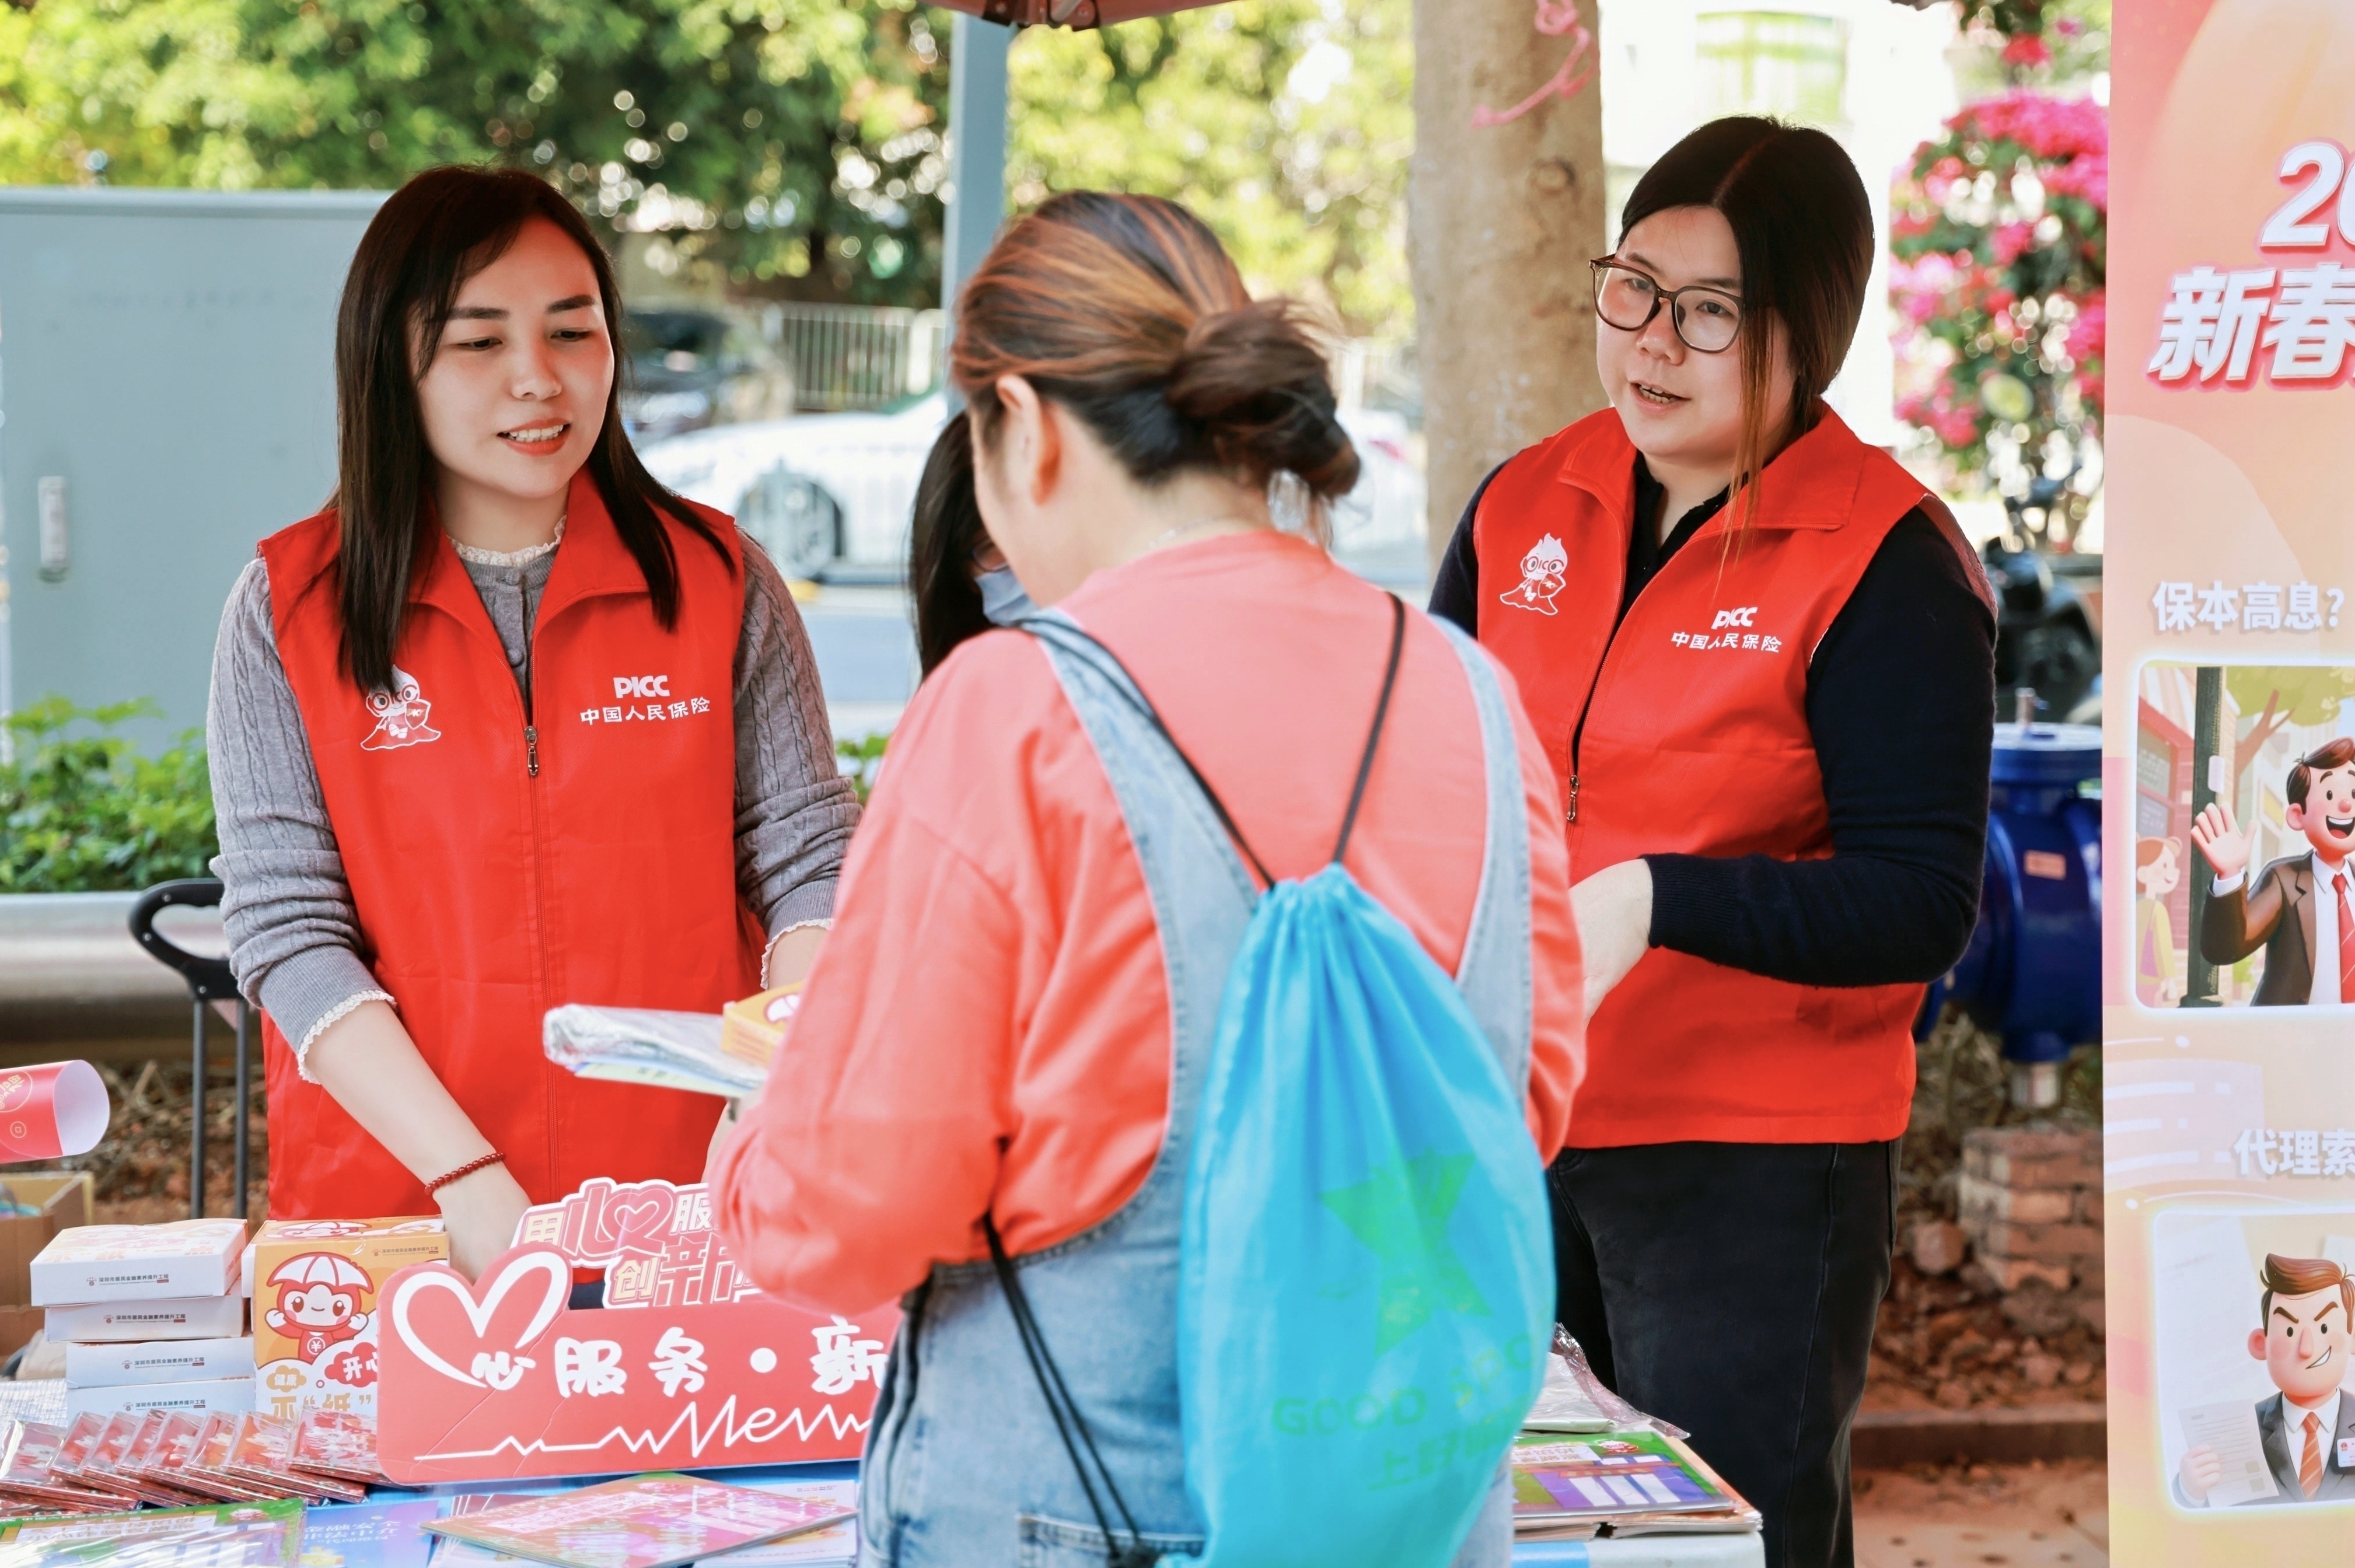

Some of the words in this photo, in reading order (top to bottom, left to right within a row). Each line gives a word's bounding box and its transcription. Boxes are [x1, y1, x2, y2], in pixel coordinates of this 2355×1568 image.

[2148, 262, 2355, 382] 新春
[1711, 607, 1758, 629] PICC
[1671, 631, 1783, 653] 中国人民保险
[613, 674, 670, 699] PICC
[579, 697, 711, 726] 中国人民保险
[2233, 1128, 2355, 1175] 代理索
[523, 1186, 719, 1257] 用心服
[612, 1231, 753, 1307] 创新
[1271, 1387, 1428, 1436] GOOD
